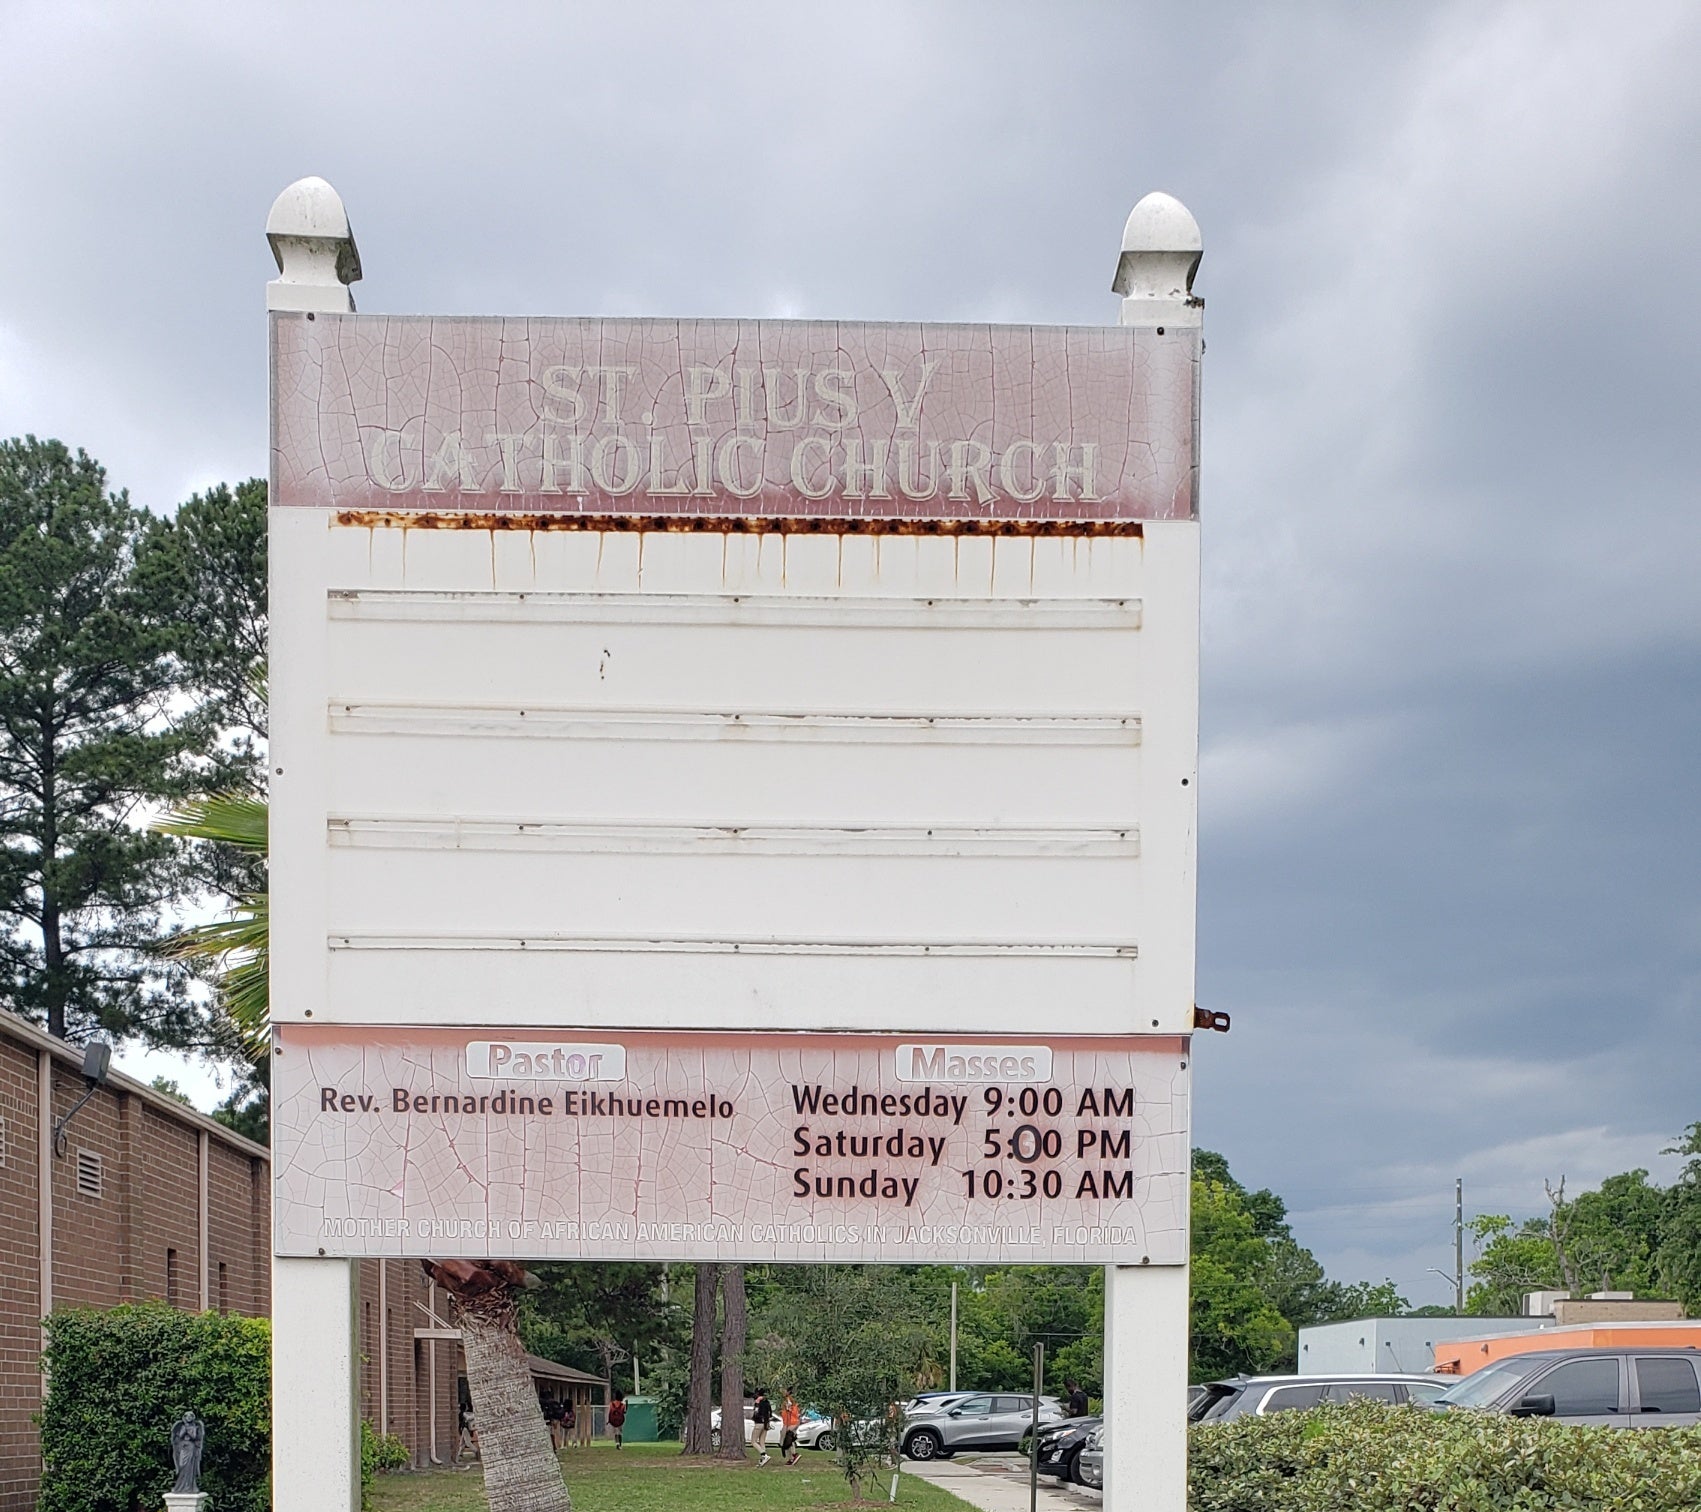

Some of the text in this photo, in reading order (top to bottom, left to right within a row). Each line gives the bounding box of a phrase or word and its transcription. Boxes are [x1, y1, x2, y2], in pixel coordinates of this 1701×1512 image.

[539, 358, 942, 432] ST. PIUS V
[370, 430, 1103, 506] CATHOLIC CHURCH
[488, 1044, 604, 1079] Pastor
[911, 1047, 1037, 1081] Masses
[320, 1087, 735, 1119] Rev. Bernardine Eikhuemelo
[792, 1085, 1135, 1125] Wednesday 9:00 AM
[793, 1126, 946, 1166] Saturday
[1077, 1129, 1132, 1160] PM
[793, 1168, 1134, 1206] Sunday 10:30 AM
[322, 1217, 411, 1239] MOTHER
[416, 1217, 501, 1240] CHURCH
[508, 1219, 535, 1240] OF
[540, 1219, 630, 1242] AFRICAN
[635, 1221, 745, 1243] AMERICAN
[749, 1223, 860, 1245] CATHOLICS
[866, 1225, 888, 1245] IN
[1052, 1225, 1138, 1246] FLORIDA
